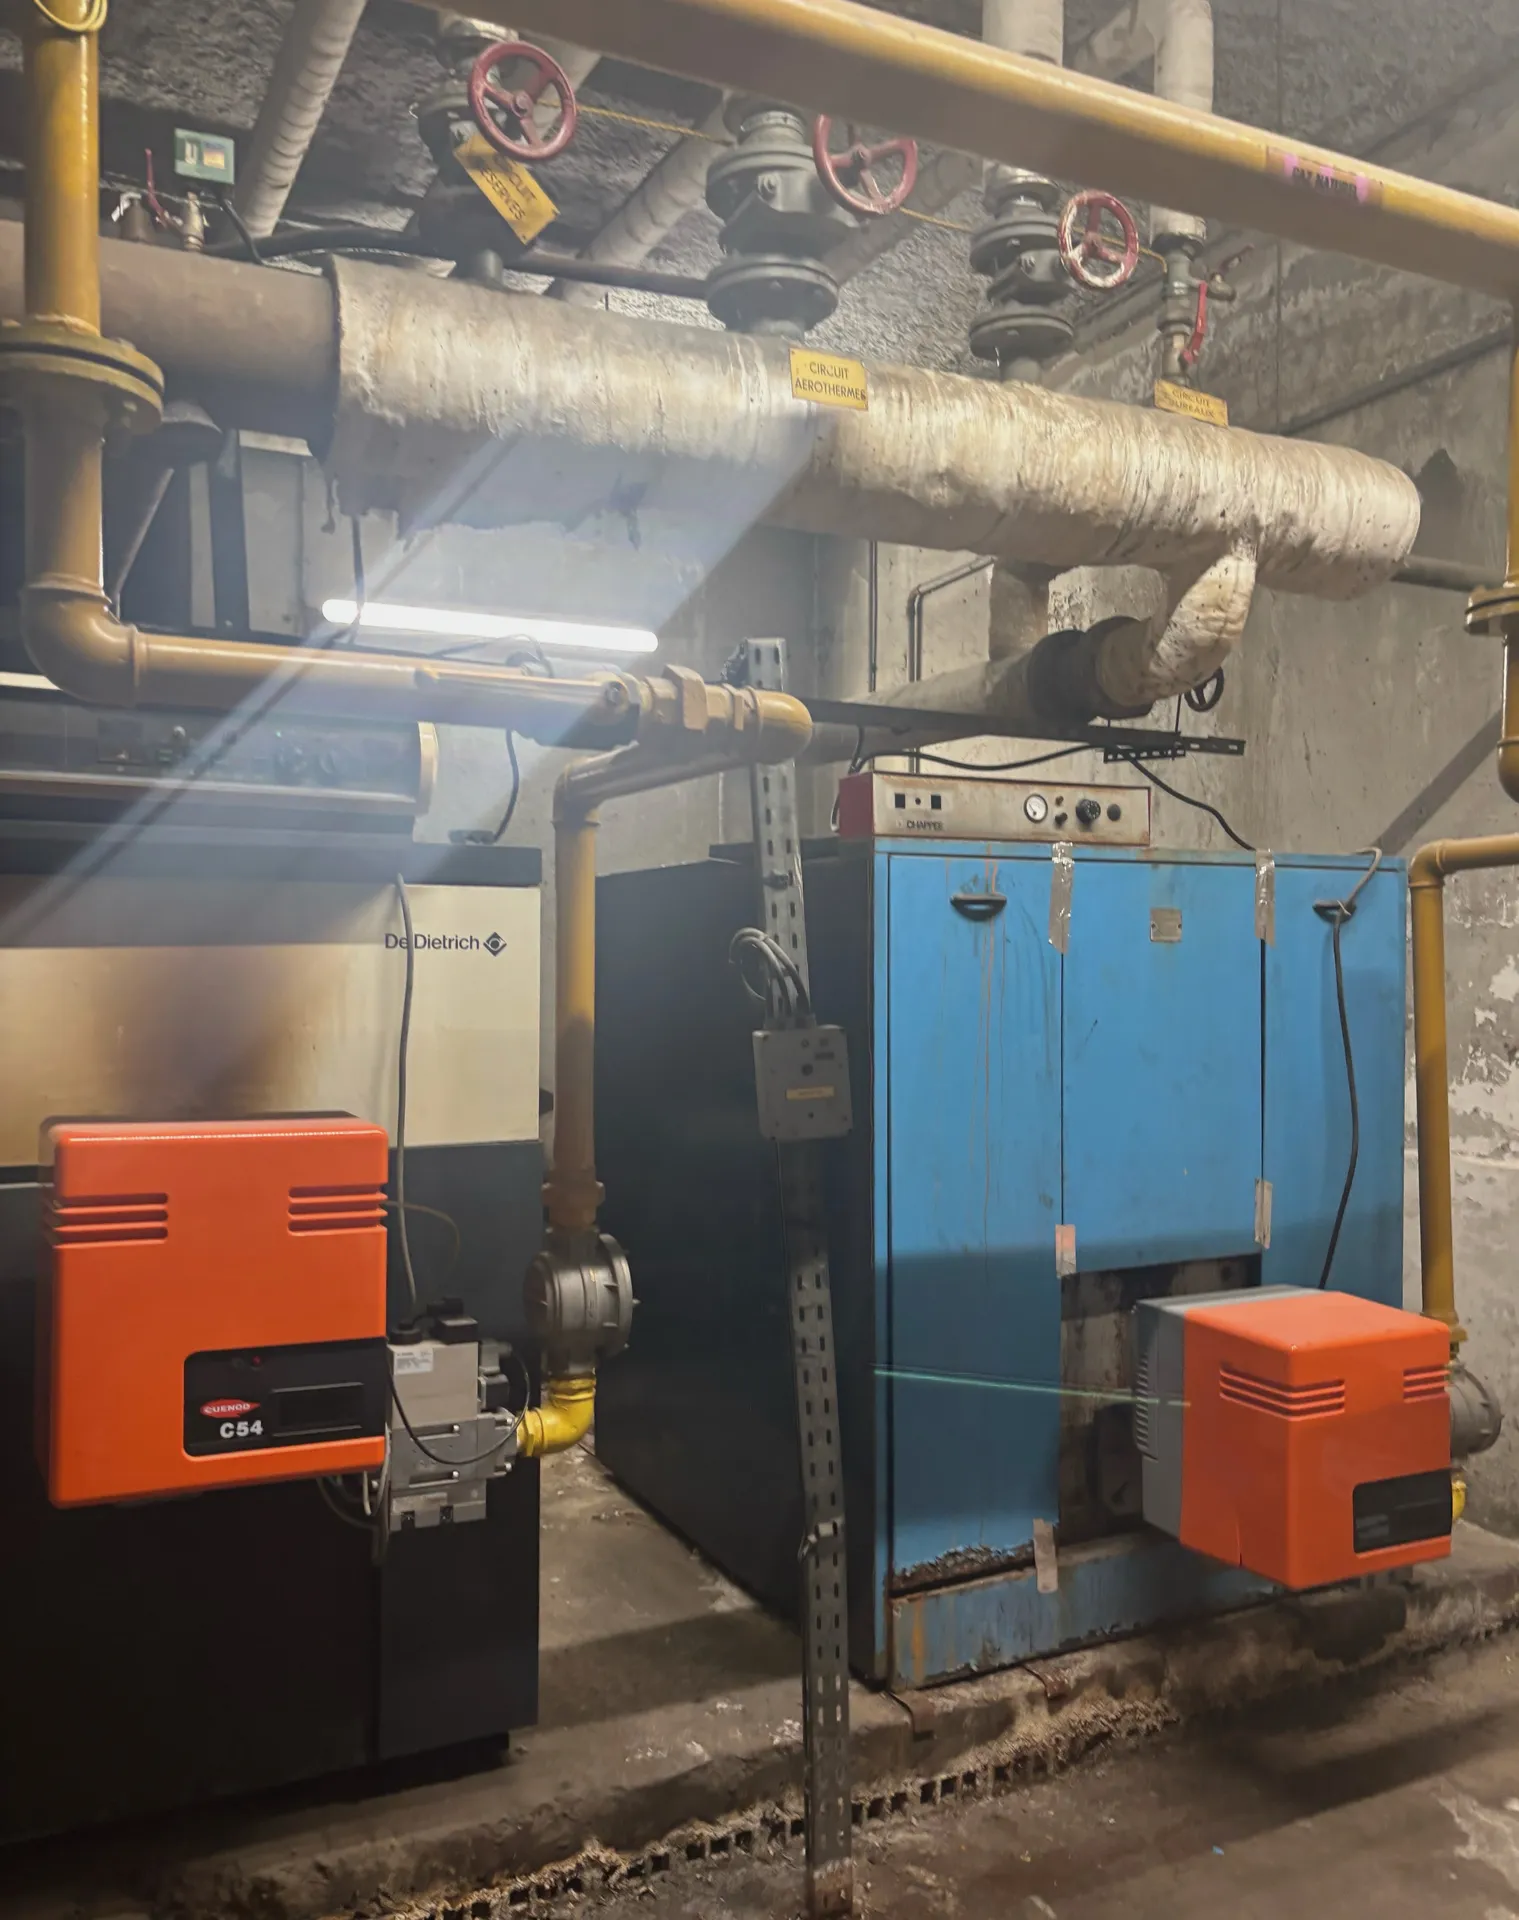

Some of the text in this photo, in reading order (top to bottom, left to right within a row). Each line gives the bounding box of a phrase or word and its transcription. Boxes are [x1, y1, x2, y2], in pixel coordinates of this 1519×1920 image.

[809, 361, 848, 380] CIRCUIT
[795, 377, 866, 401] AEROTHERMES
[385, 933, 480, 950] De Dietrich
[203, 1403, 251, 1414] CUENOD
[220, 1420, 264, 1438] C54
